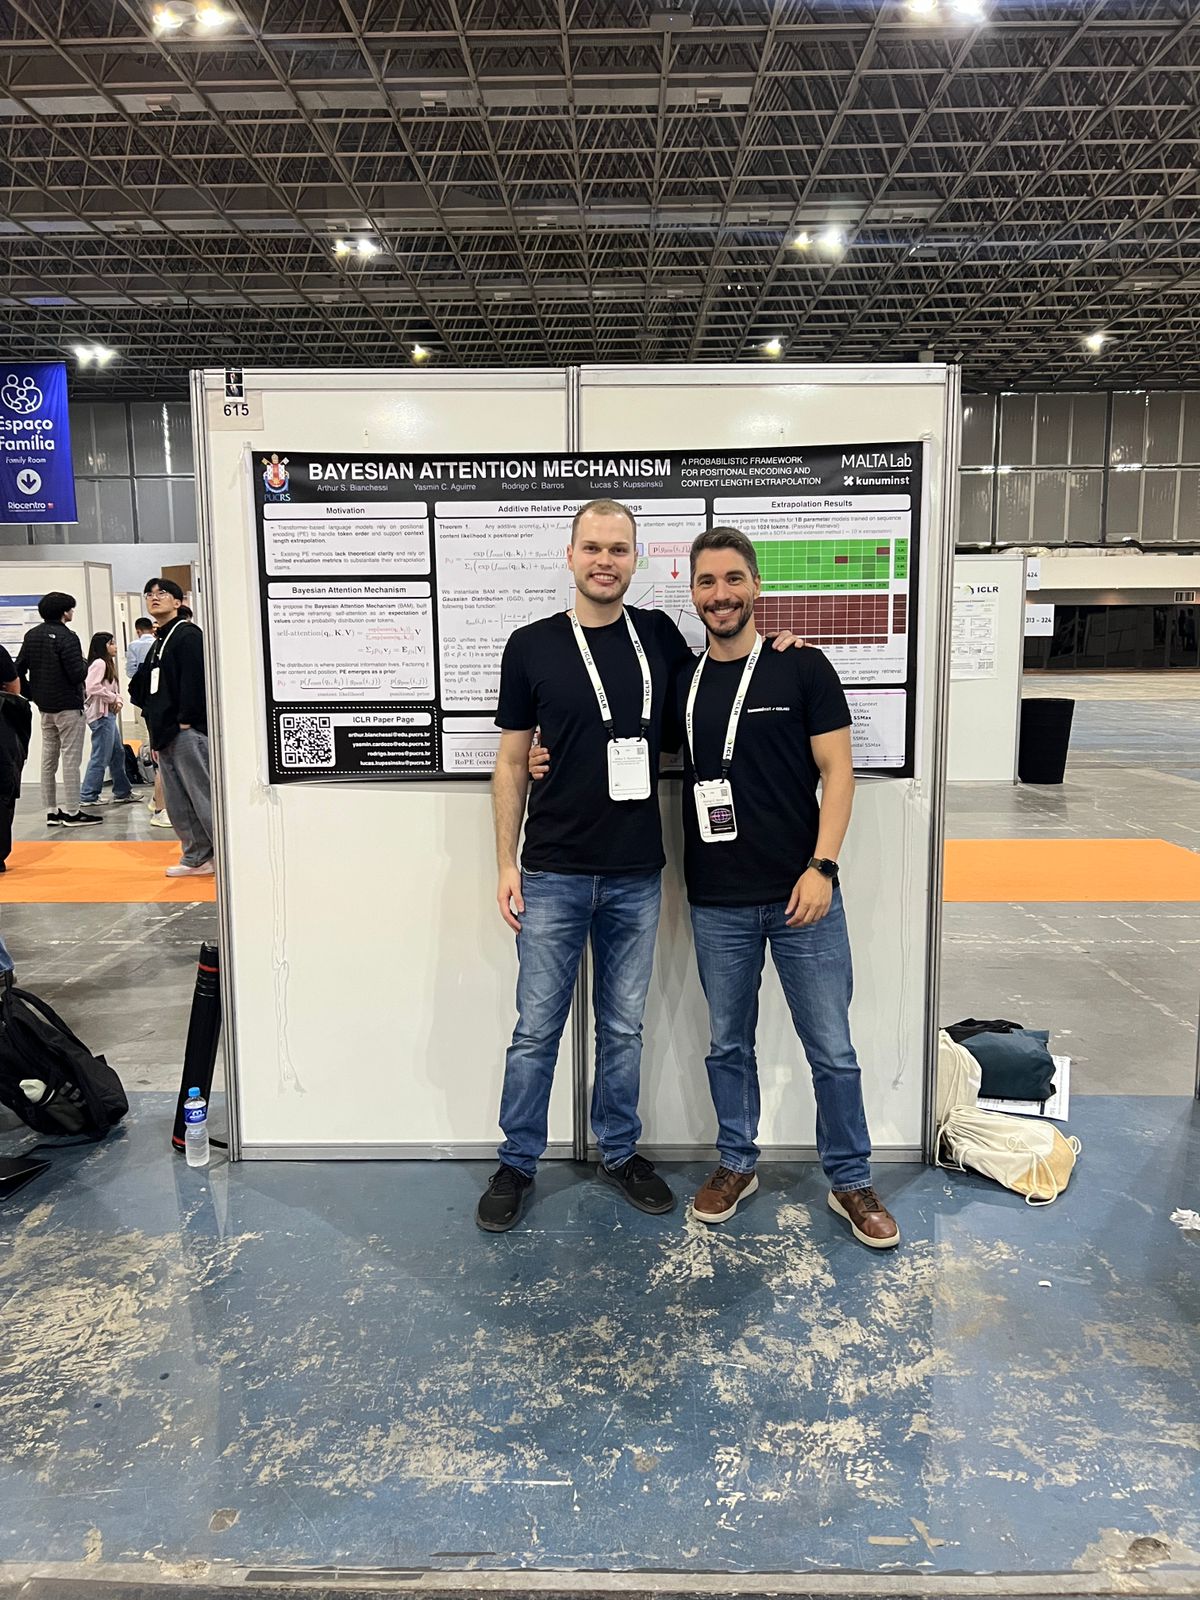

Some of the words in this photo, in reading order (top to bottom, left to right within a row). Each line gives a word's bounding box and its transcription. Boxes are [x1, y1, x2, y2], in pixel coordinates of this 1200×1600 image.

[224, 404, 249, 416] 615
[0, 416, 53, 434] Espaço
[0, 434, 55, 450] Família
[6, 457, 26, 465] Family
[750, 456, 803, 464] FRAMEWORK
[841, 454, 887, 468] MALTA
[890, 453, 912, 468] Lab
[309, 462, 413, 480] BAYESIAN
[419, 460, 536, 479] ATTENTION
[543, 458, 671, 478] MECHANISM
[700, 468, 747, 476] POSITIONAL
[451, 483, 476, 491] Aguirre
[721, 478, 752, 486] LENGTH
[754, 477, 821, 486] EXTRAPOLATION
[856, 476, 910, 486] kunuminst
[771, 500, 822, 509] Extrapolation
[824, 500, 852, 508] Results
[584, 650, 592, 666] ICLR
[747, 656, 756, 670] ICLR
[599, 690, 607, 709] ICLR
